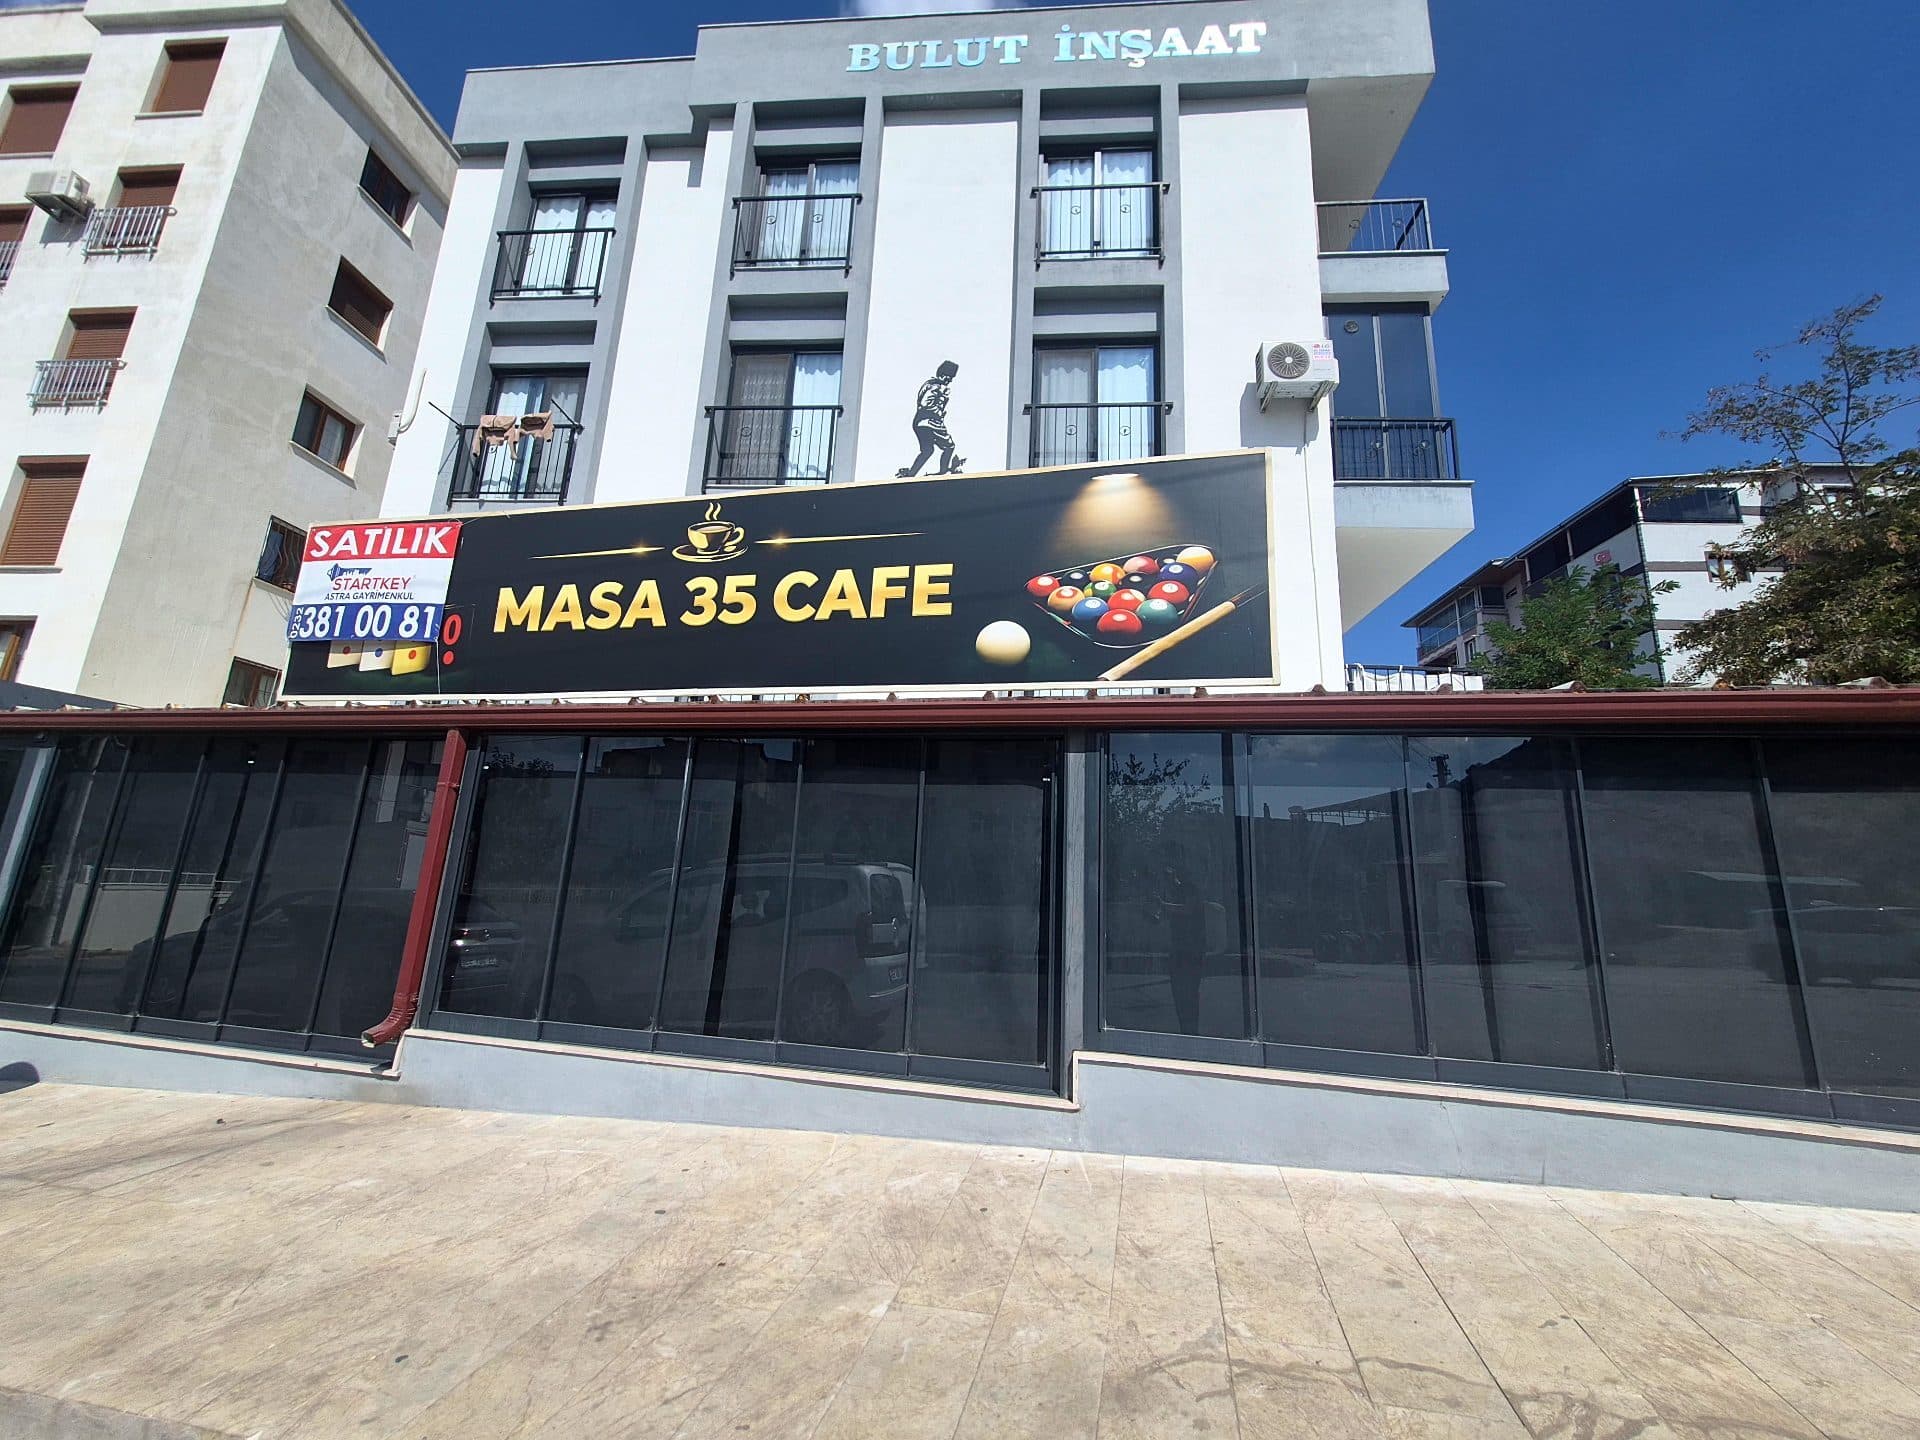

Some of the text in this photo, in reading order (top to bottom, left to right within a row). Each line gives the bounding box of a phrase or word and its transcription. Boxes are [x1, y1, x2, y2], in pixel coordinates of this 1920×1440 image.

[845, 22, 1267, 72] BULUT İNŞAAT
[310, 526, 452, 558] SATILIK
[324, 592, 351, 601] ASTRA
[332, 577, 412, 591] STARTKEY
[493, 563, 955, 633] MASA 35 CAFE
[288, 606, 304, 639] 0232
[299, 604, 436, 638] 381 00 81
